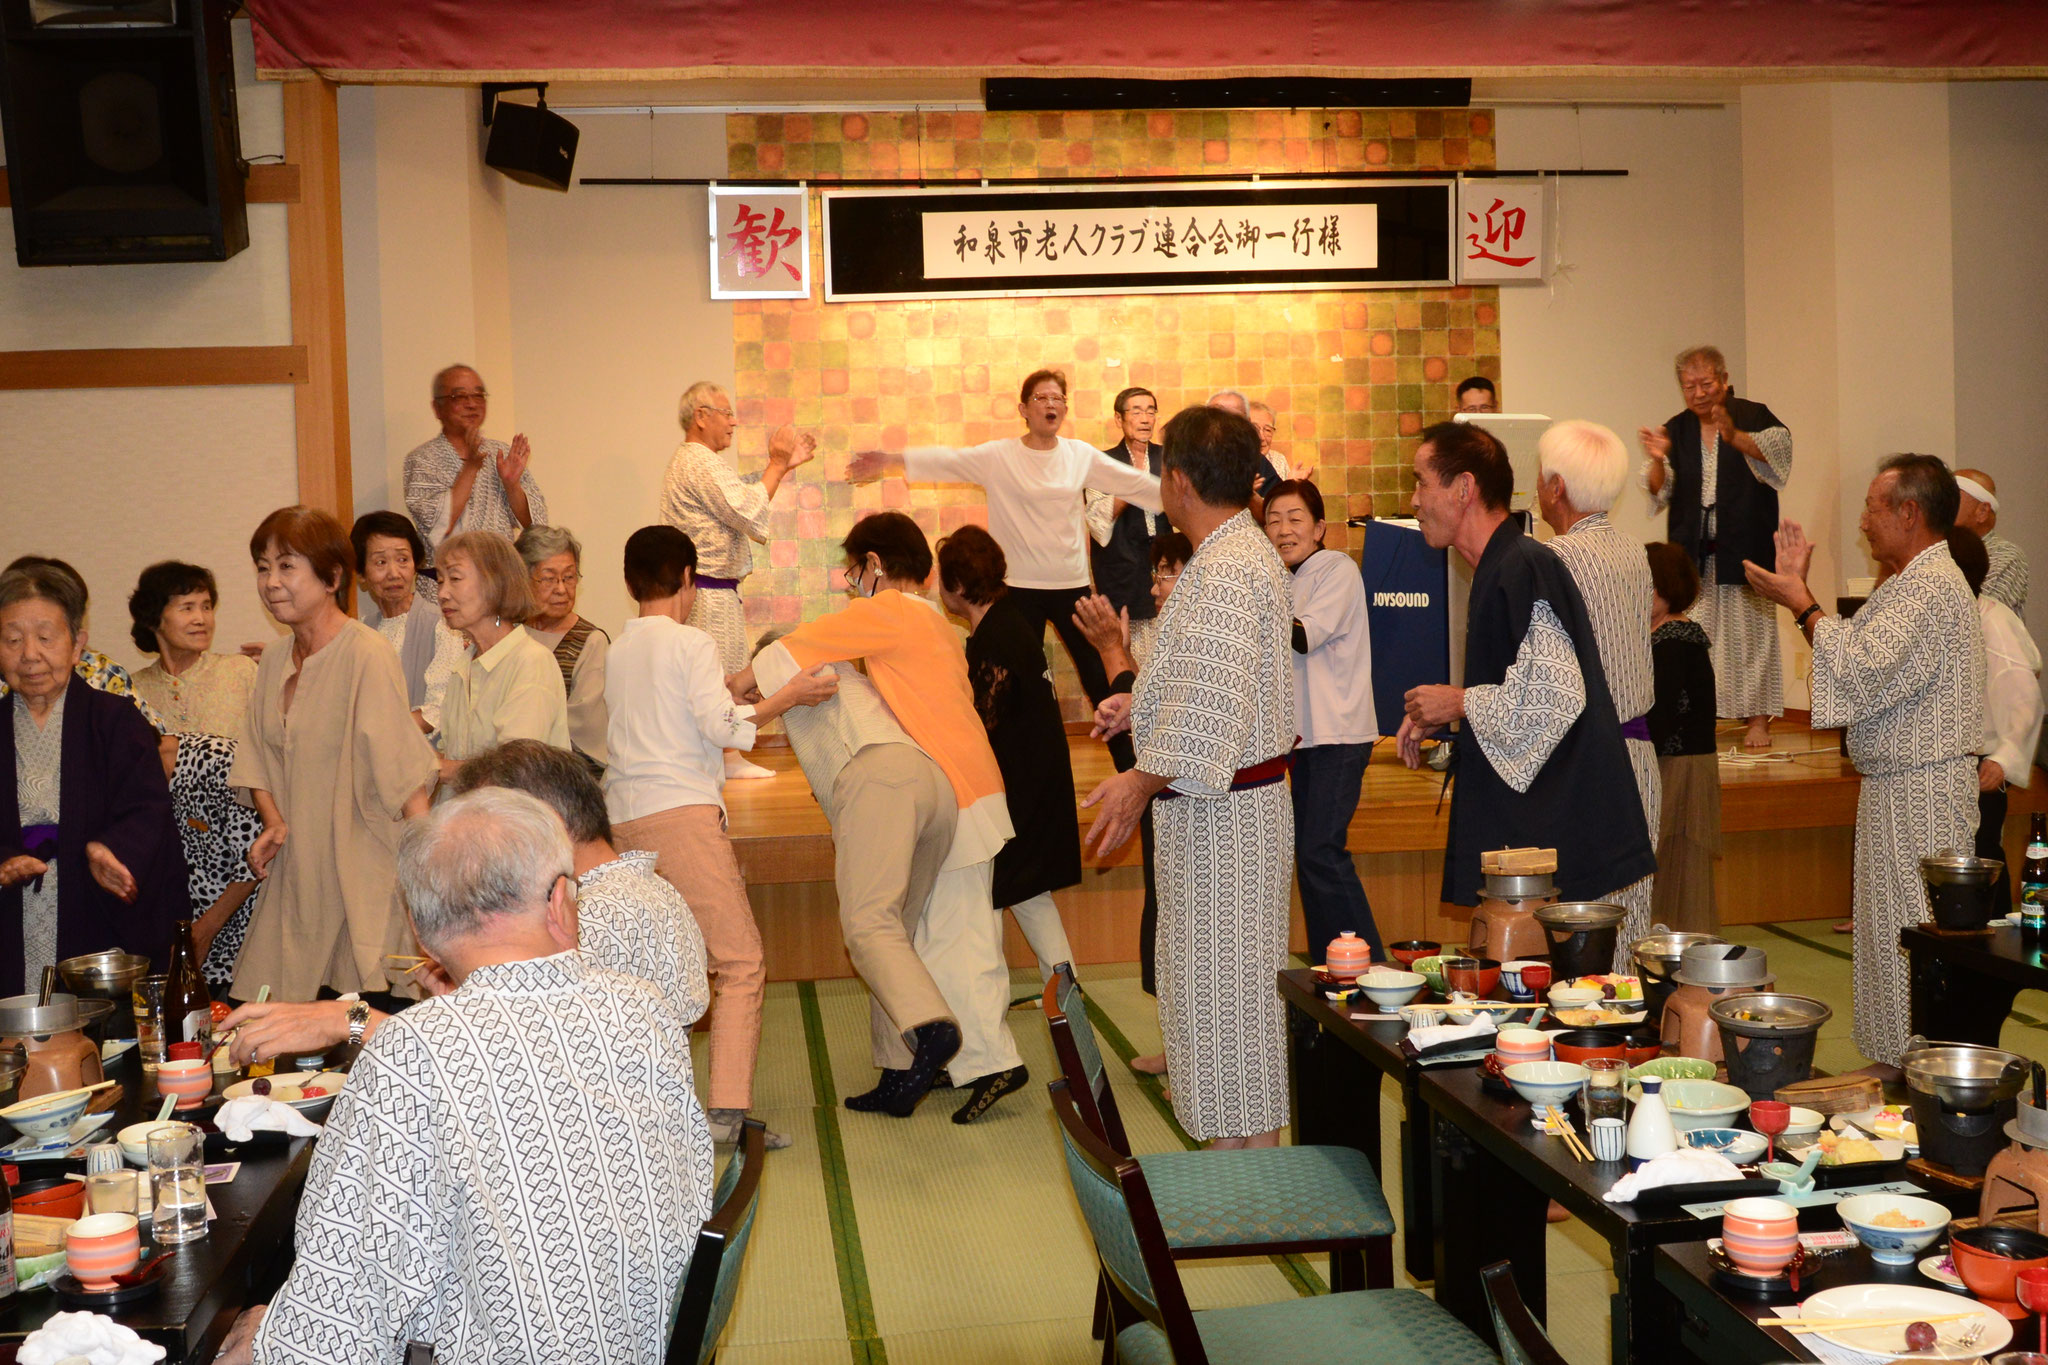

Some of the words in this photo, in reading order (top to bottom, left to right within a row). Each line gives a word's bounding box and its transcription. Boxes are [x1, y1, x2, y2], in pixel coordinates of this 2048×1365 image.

[721, 203, 802, 281] 歓
[953, 214, 1342, 266] 和泉市老人クラブ連合会御一行様
[1465, 198, 1537, 267] 迎
[1373, 592, 1430, 607] JOYSOUND
